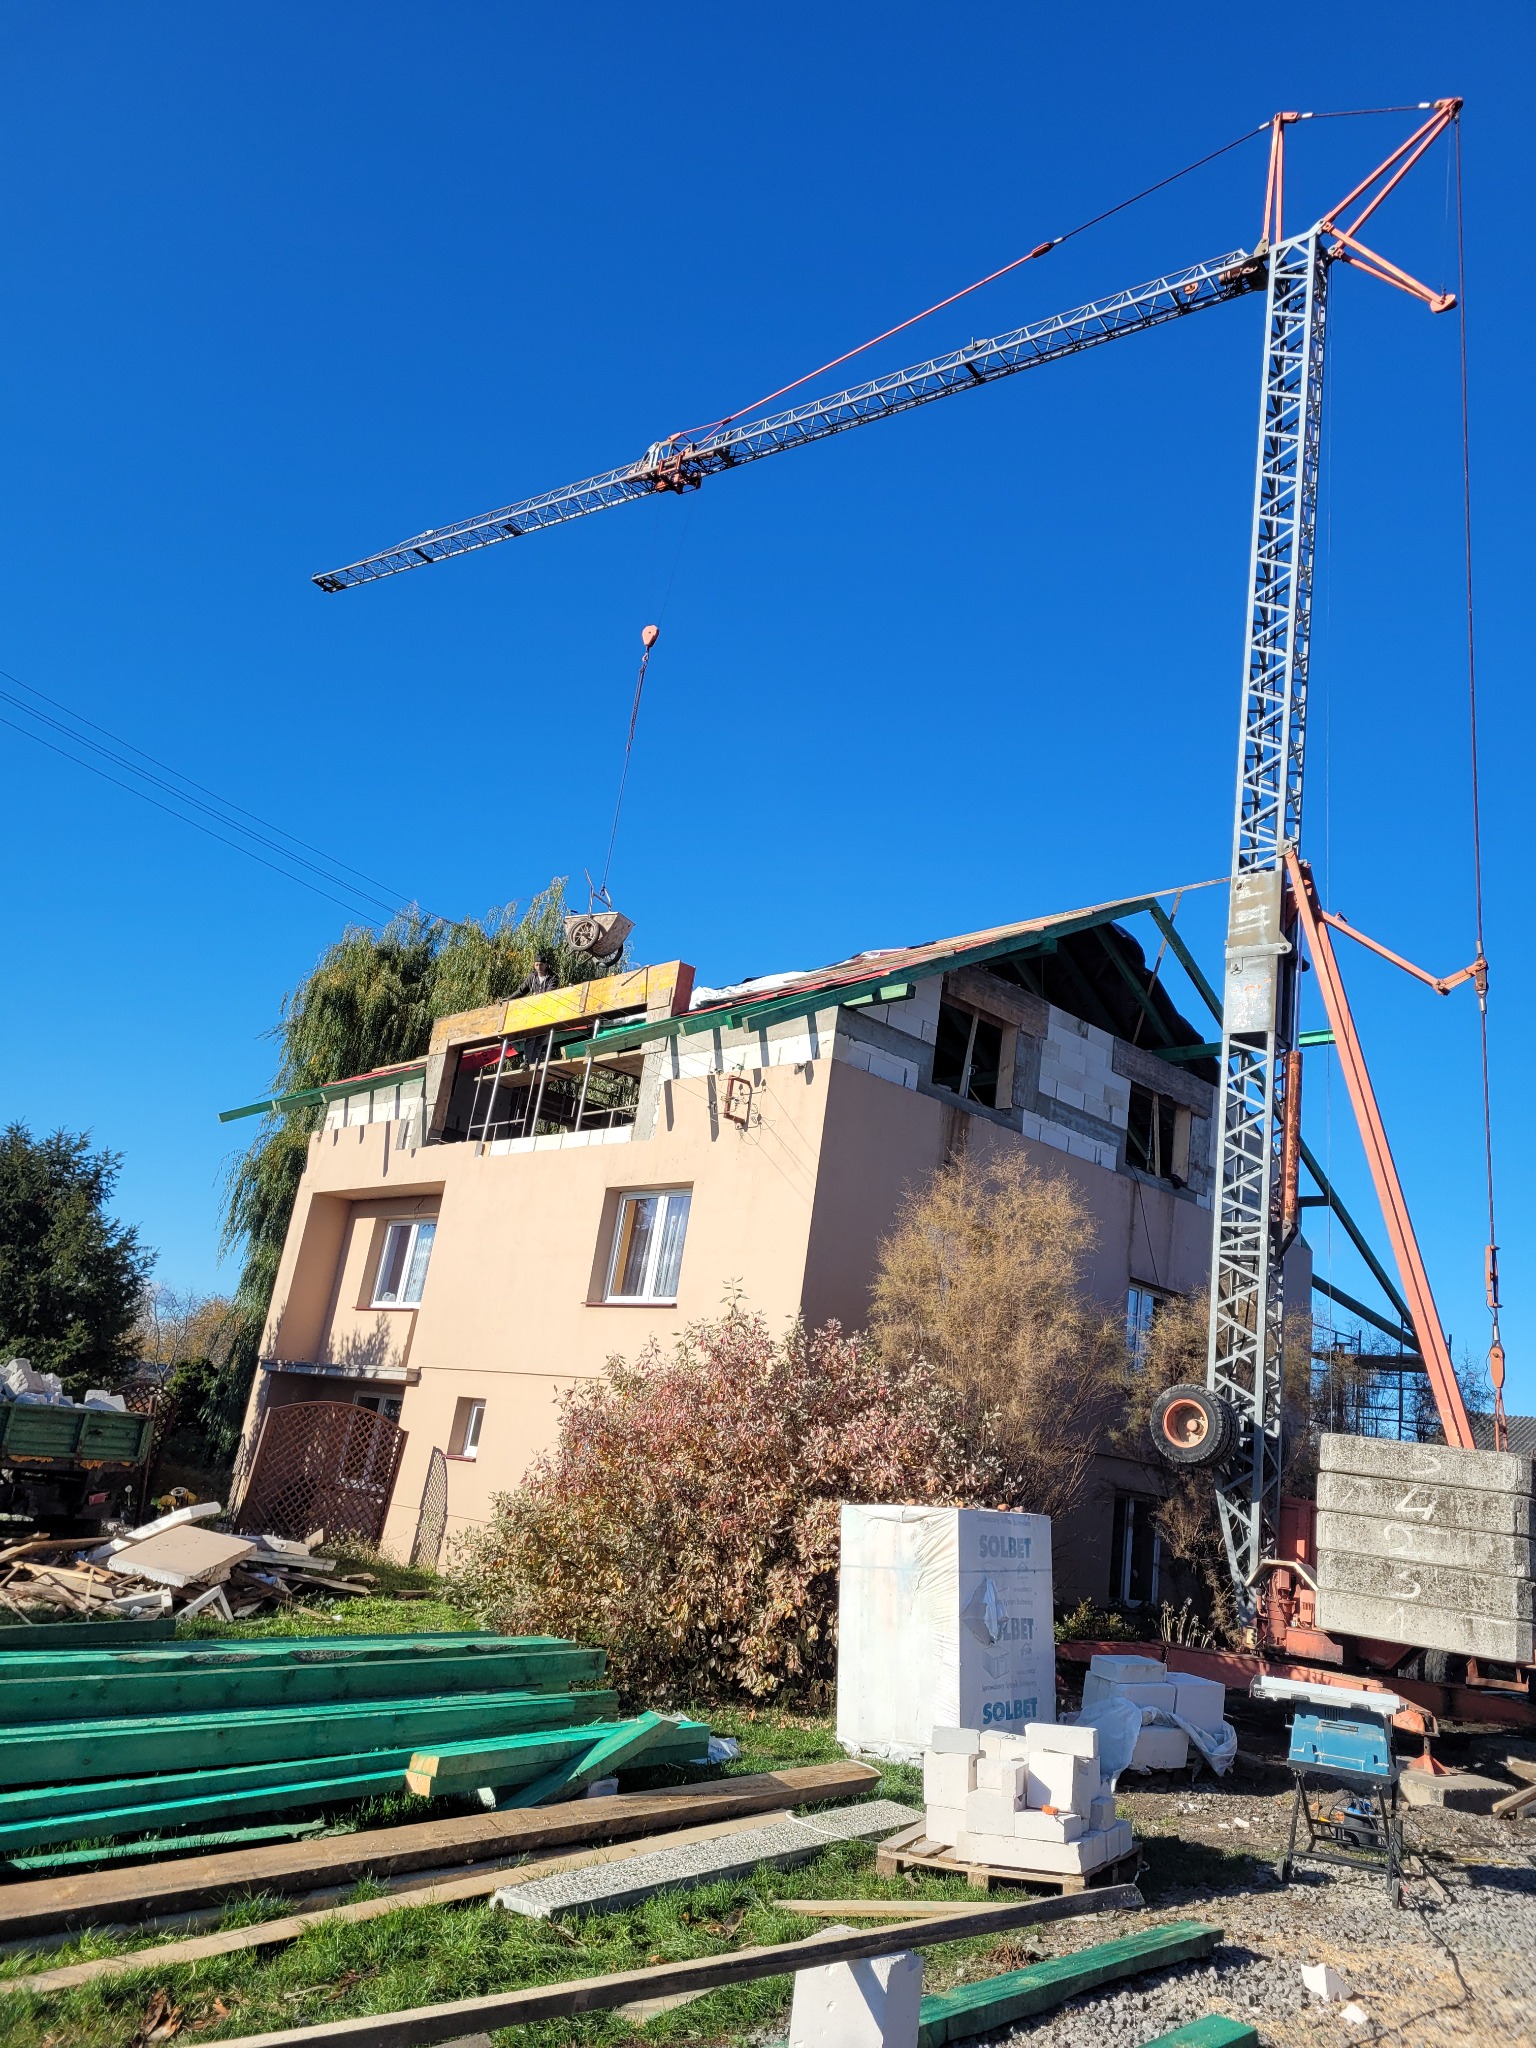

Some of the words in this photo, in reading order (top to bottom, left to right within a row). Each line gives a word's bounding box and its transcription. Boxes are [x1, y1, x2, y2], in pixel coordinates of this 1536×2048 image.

[1395, 1485, 1438, 1520] 4
[979, 1534, 1032, 1559] SOLBET
[1383, 1523, 1416, 1555] 2
[997, 1617, 1034, 1641] LBET
[982, 1697, 1038, 1725] SOLBET
